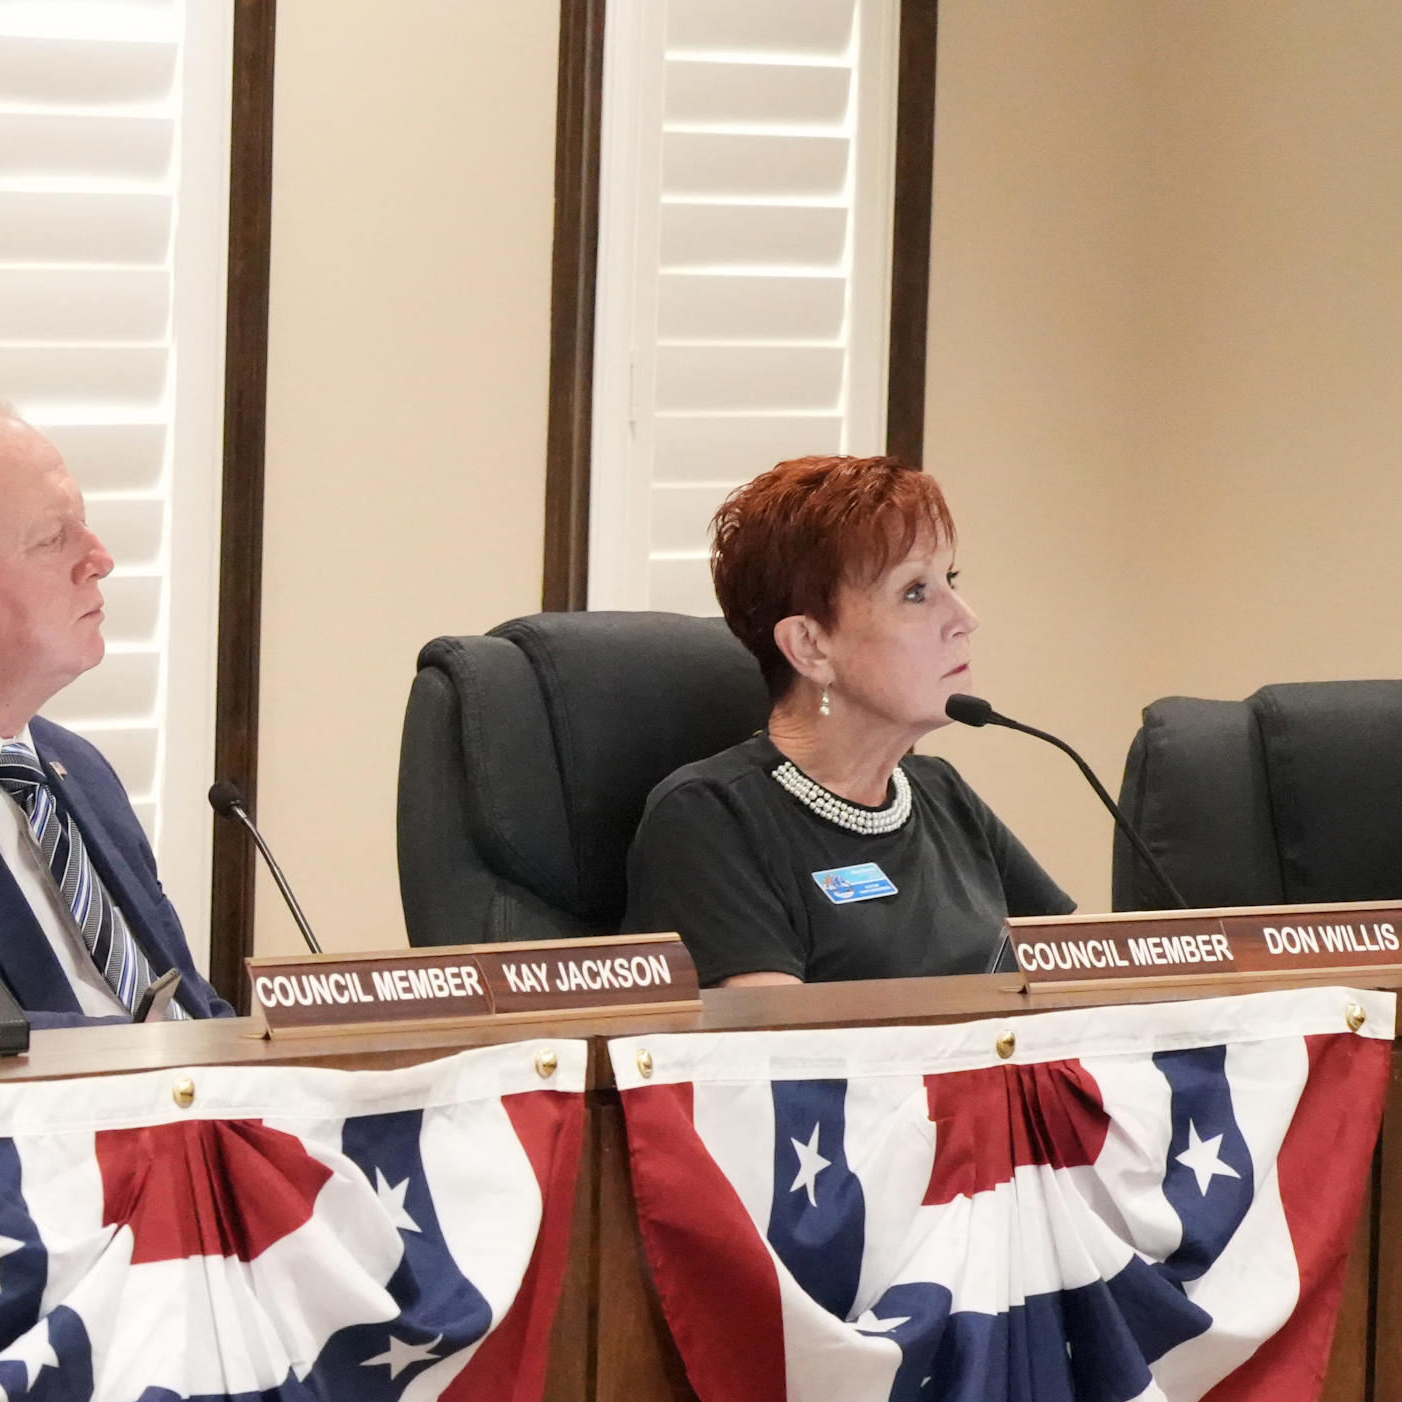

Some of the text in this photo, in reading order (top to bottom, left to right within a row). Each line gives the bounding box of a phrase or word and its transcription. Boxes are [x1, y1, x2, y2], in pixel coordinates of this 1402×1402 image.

[1016, 922, 1400, 972] COUNCIL MEMBER DON WILLIS
[256, 954, 672, 1008] COUNCIL MEMBER KAY JACKSON
